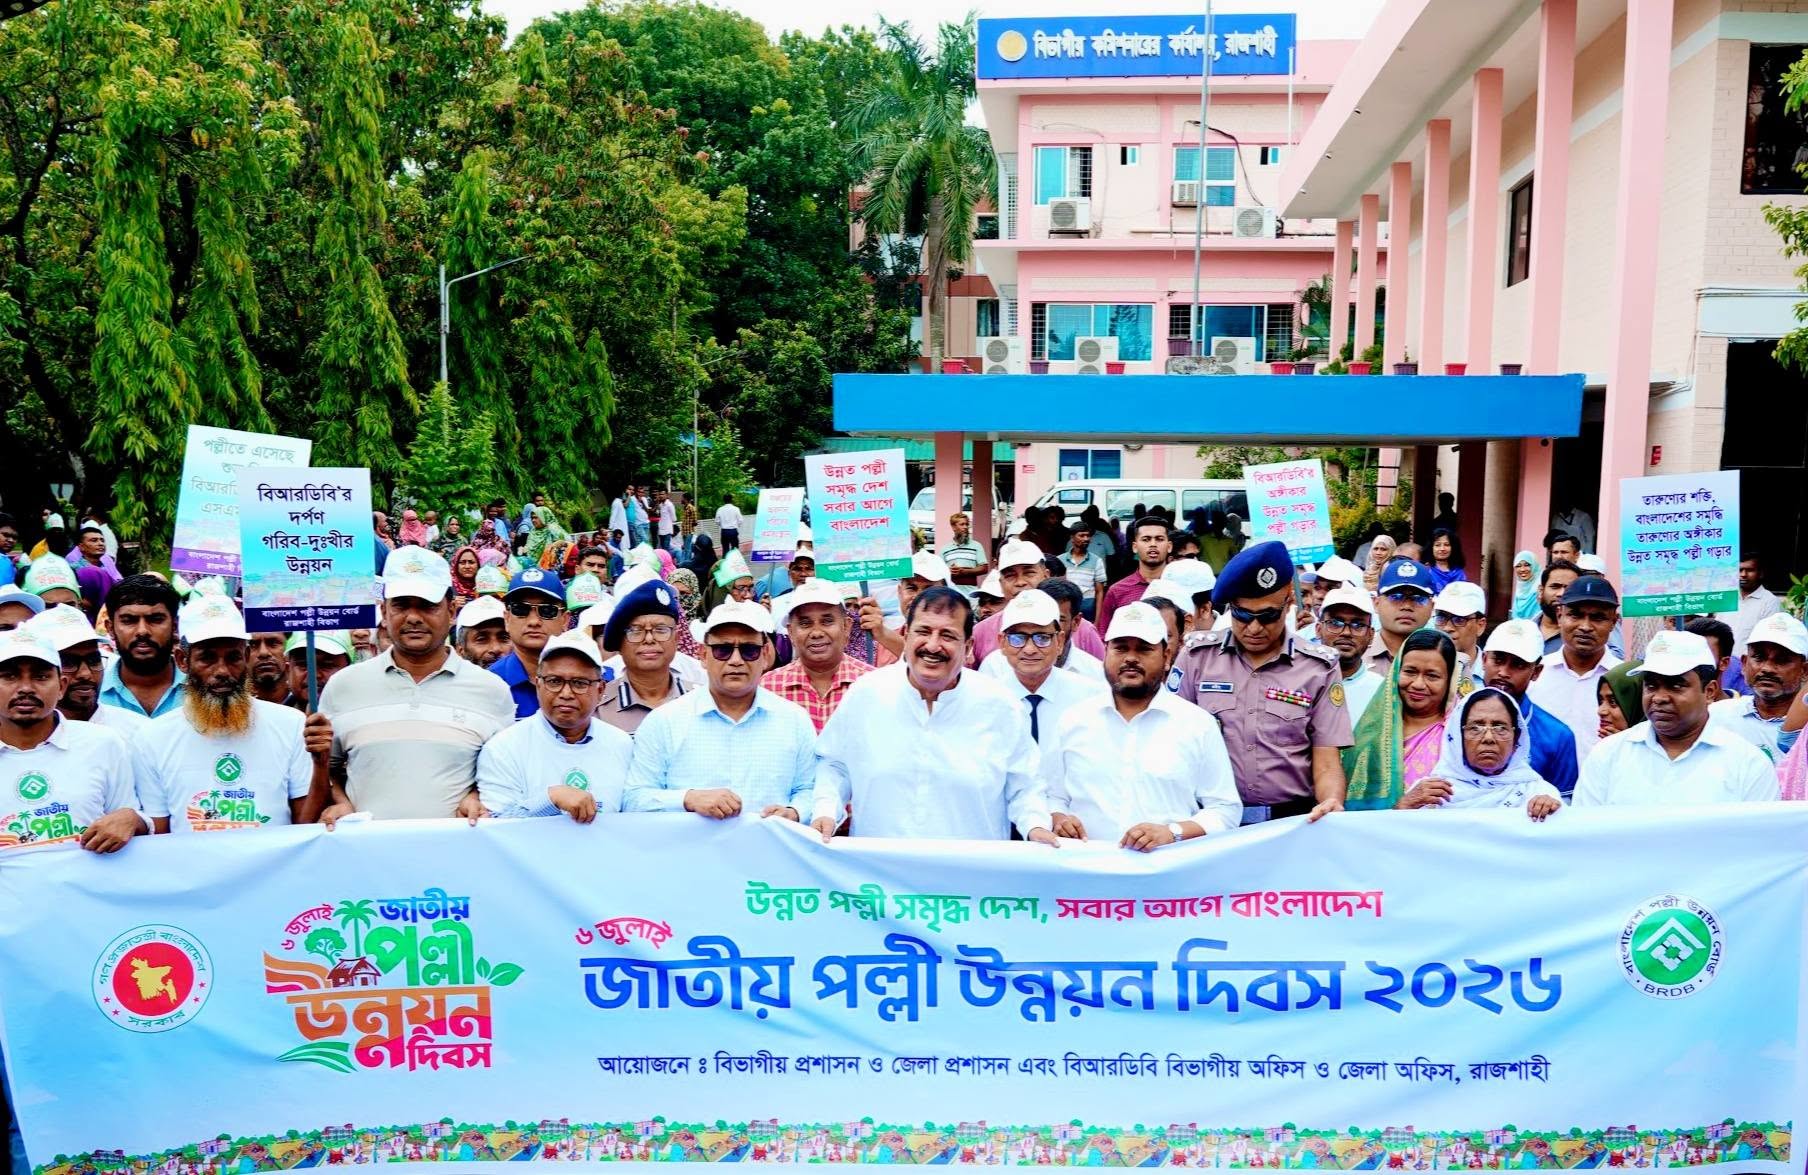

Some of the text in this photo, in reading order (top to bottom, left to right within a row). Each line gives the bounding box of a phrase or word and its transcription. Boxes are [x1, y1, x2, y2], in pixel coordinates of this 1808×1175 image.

[1032, 28, 1086, 60] বিভাগীয়
[1224, 25, 1278, 60] রাজশাহী
[204, 436, 296, 464] পল্লীতে এসেছে
[824, 459, 888, 478] উন্নত পল্লী
[824, 480, 888, 498] সমৃদ্ধ দেশ
[1642, 493, 1686, 506] তারুণ্যের
[288, 507, 325, 526] দর্পণ
[824, 498, 894, 514] সবার আগে
[830, 516, 890, 532] বাংলাদেশ
[1636, 511, 1692, 525] বাংলাদেশের
[262, 530, 354, 552] গরিব-দুঃখীর
[1636, 525, 1722, 543] তারুণ্যের অঙ্গীকার
[1627, 544, 1732, 564] উন্নত সমৃদ্ধ পল্লী গড়ার
[286, 556, 332, 576] উন্নয়ন
[262, 610, 298, 618] বাংলাদেশ
[318, 608, 340, 617] উন্নয়ন
[342, 606, 360, 615] বোর্ড
[284, 618, 340, 627] রাজশাহী বিভাগ
[34, 802, 69, 816] জাতীয়
[30, 812, 74, 839] পল্লী
[378, 887, 470, 924] জাতীয়
[745, 881, 1384, 933] উন্নত পল্লী সমৃদ্ধ দেশ, সবার আগে বাংলাদেশ
[1649, 895, 1680, 908] পল্লী
[1688, 900, 1720, 935] উন্নয়ন
[281, 904, 334, 950] ৬ জুলাই
[575, 917, 673, 949] ৬ জুলাই
[160, 932, 206, 971] বাংলাদেশ
[363, 919, 476, 986] পল্লী
[580, 933, 1562, 1022] জাতীয় পল্লী উন্নয়ন দিবস ২০২৬
[1644, 983, 1695, 996] BRDB
[128, 1010, 185, 1028] সরকার
[286, 986, 492, 1070] উন্নয়ন
[407, 1030, 492, 1072] দিবস
[597, 1055, 690, 1075] আয়োজনে
[714, 1050, 786, 1075] বিভাগীয়
[796, 1056, 860, 1075] প্রশাসন
[869, 1056, 883, 1074] ও
[892, 1056, 938, 1075] জেলা
[945, 1056, 1011, 1076] প্রশাসন
[1019, 1057, 1058, 1077] এবং
[1063, 1052, 1158, 1078] বিআরডিবি
[1166, 1054, 1240, 1079] বিভাগীয়
[1249, 1055, 1305, 1080] অফিস
[1315, 1062, 1329, 1079] ও
[1338, 1061, 1386, 1081] জেলা
[1394, 1056, 1461, 1084] অফিস,
[1470, 1054, 1552, 1082] রাজশাহী
